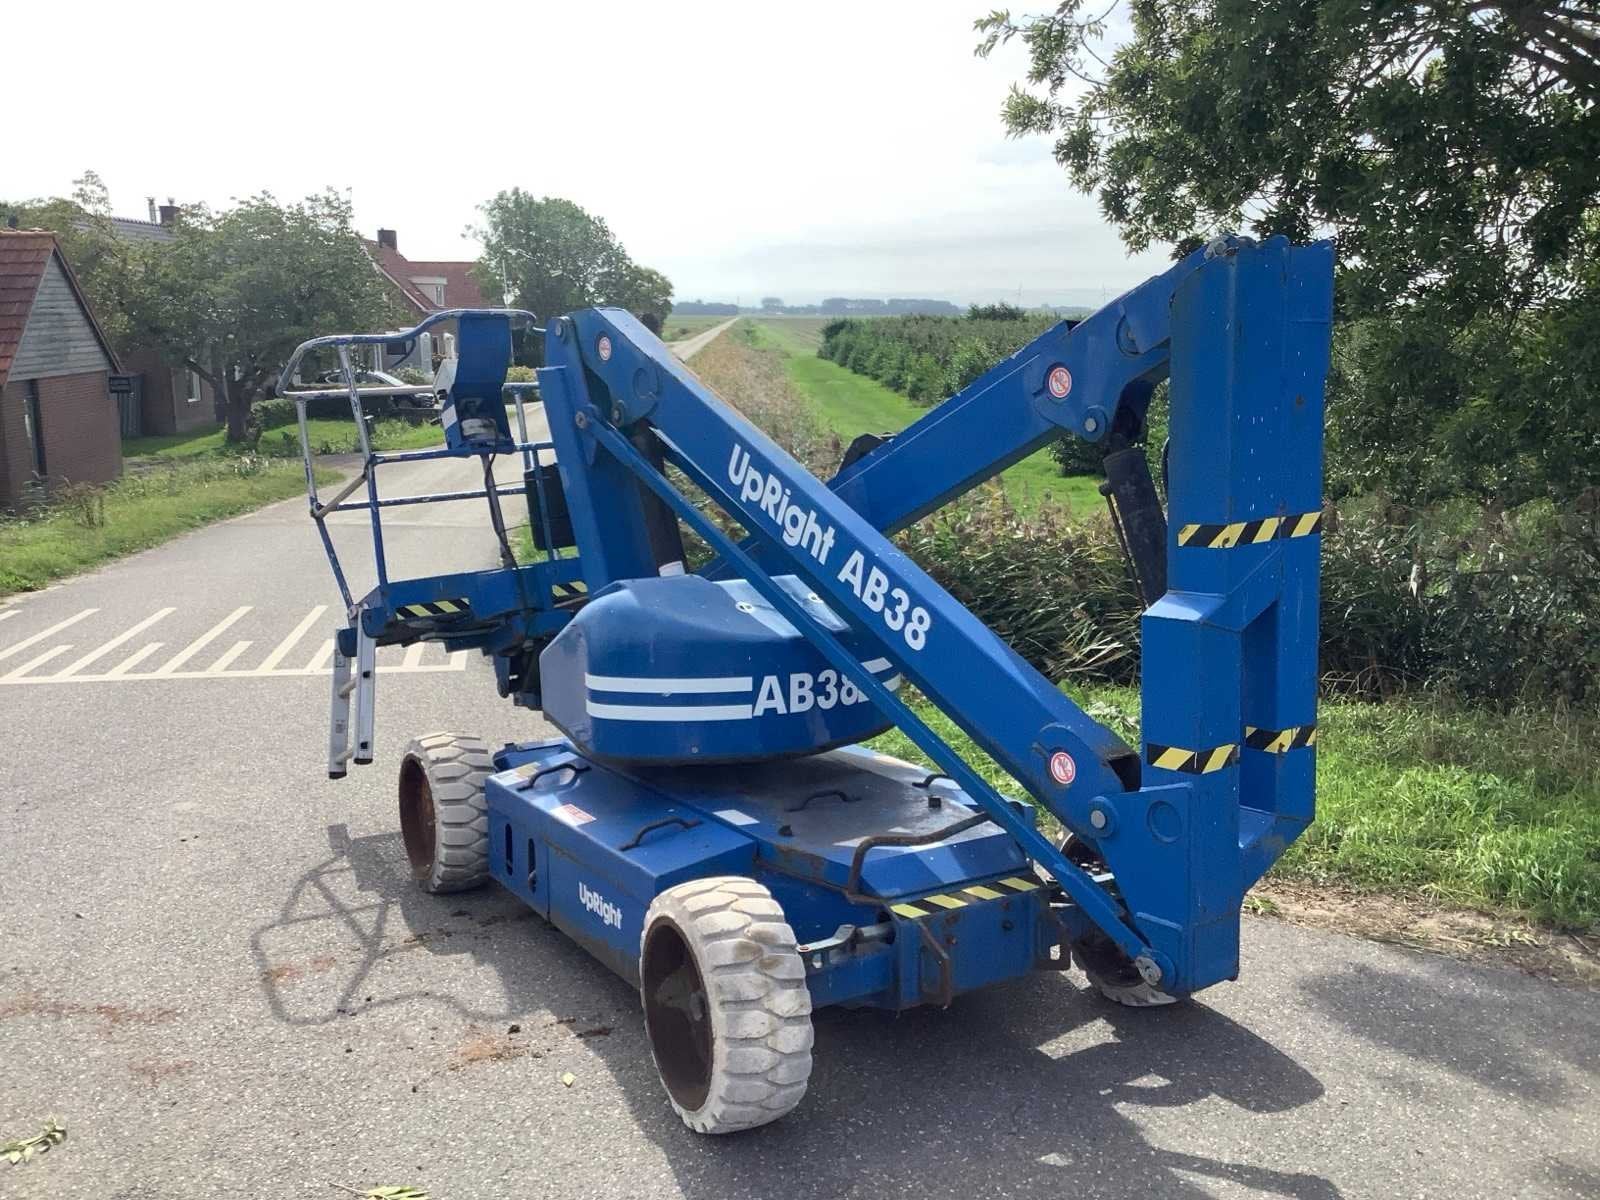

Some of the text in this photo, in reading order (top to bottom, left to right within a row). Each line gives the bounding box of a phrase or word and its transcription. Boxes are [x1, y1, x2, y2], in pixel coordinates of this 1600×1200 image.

[728, 444, 931, 651] UpRight AB38
[578, 881, 622, 930] UpRight
